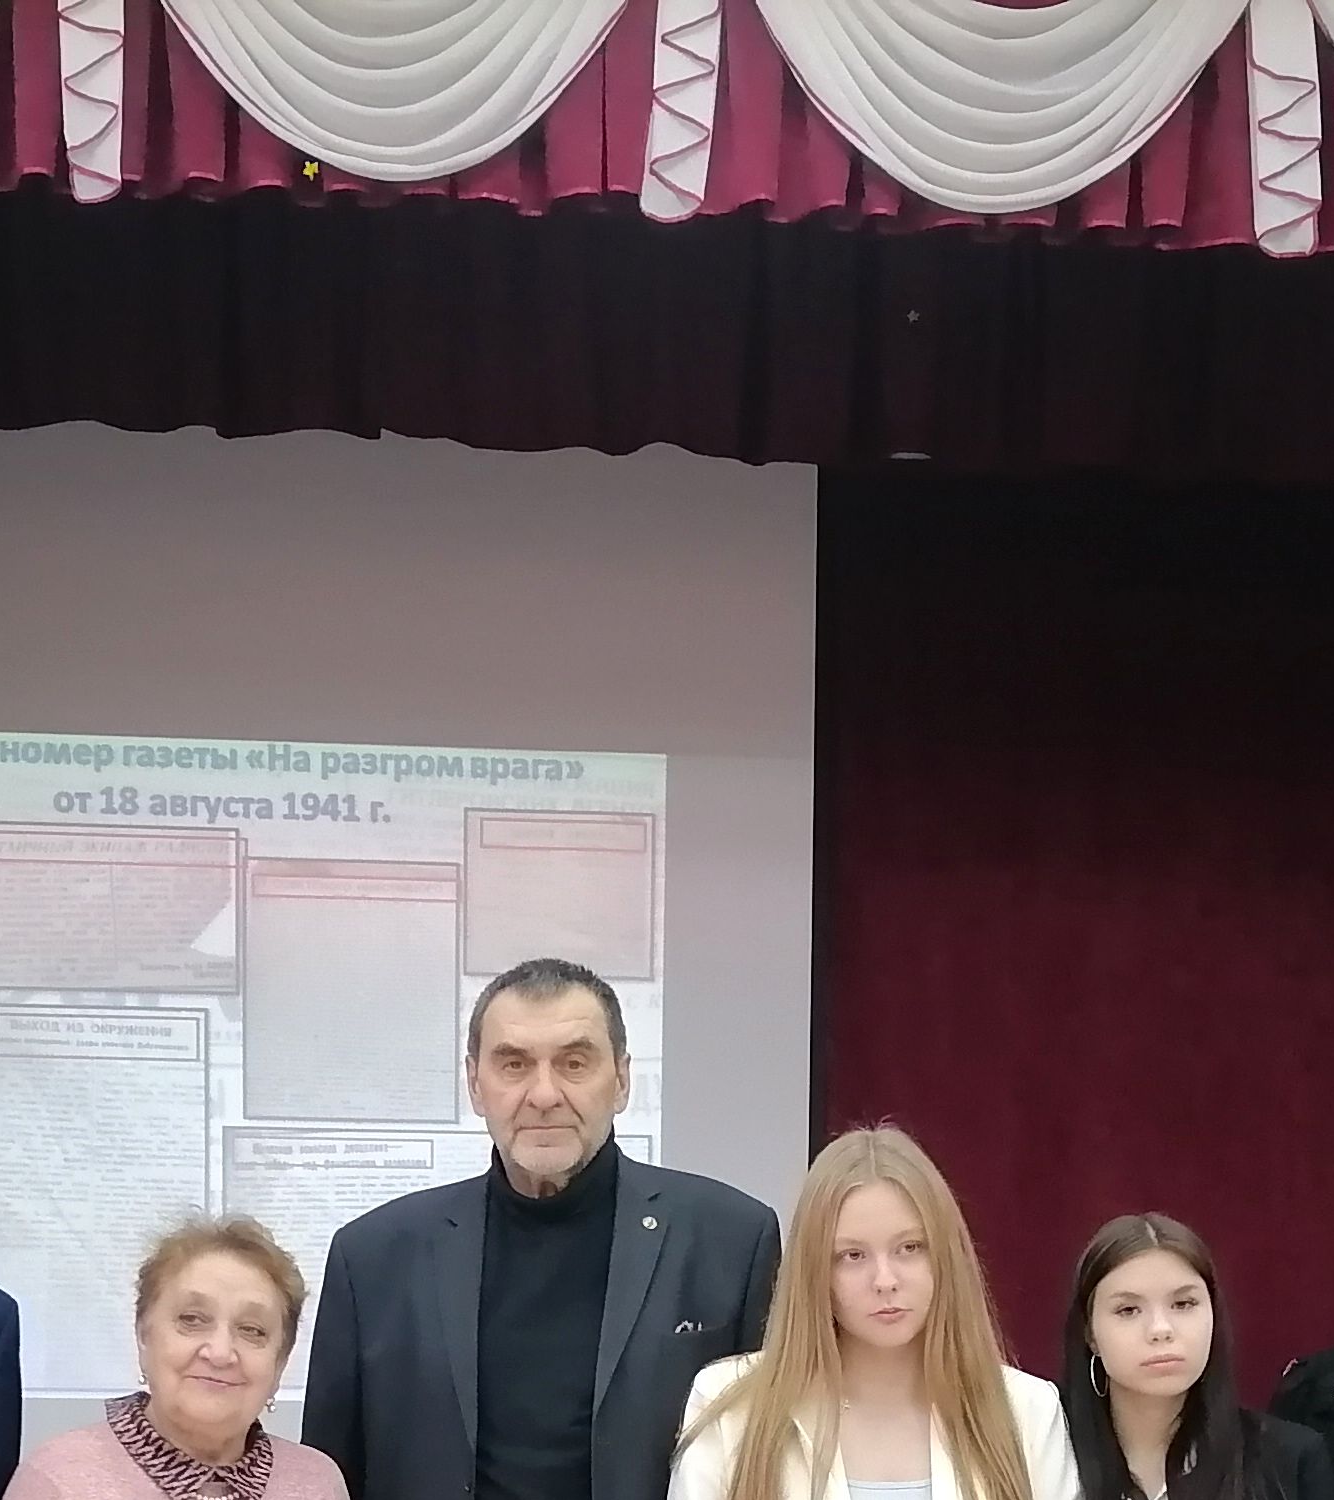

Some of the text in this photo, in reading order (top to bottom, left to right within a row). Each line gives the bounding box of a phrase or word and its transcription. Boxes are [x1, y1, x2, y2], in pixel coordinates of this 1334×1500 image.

[0, 740, 115, 772] номер
[122, 743, 238, 771] газеты
[244, 744, 311, 774] «На
[321, 751, 465, 782] разгром
[470, 756, 584, 785] врага»
[53, 786, 391, 824] от 18 августа 1941 г.
